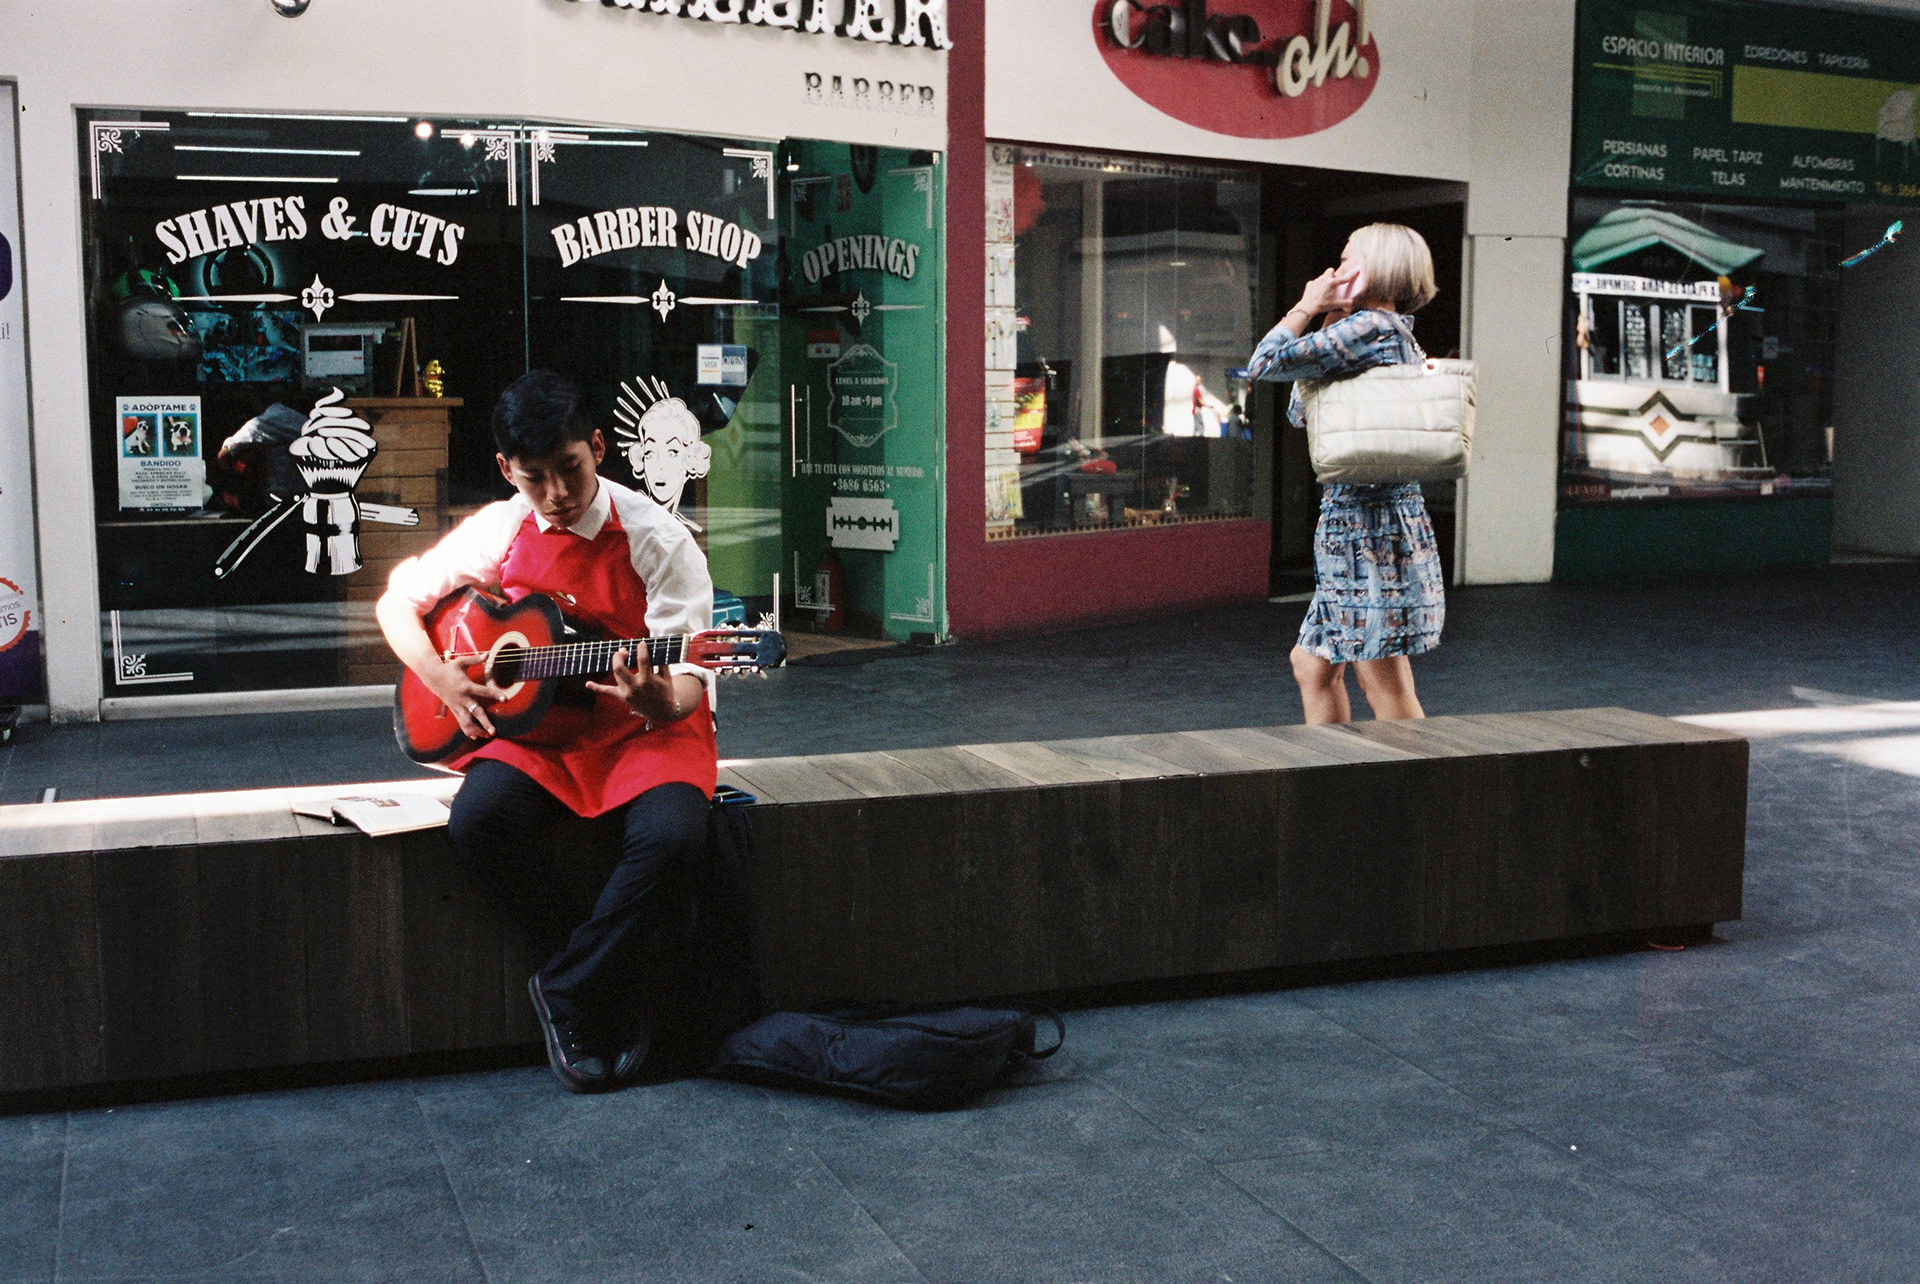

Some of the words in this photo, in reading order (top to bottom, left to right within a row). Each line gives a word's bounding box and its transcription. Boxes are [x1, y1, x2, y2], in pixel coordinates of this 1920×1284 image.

[1276, 0, 1370, 98] oh!
[1602, 35, 1659, 59] ESPACIO
[1664, 42, 1724, 66] INTERIOR
[1602, 139, 1668, 159] PERSIANAS
[1693, 147, 1728, 164] PAPEL
[1732, 149, 1763, 166] TAPIZ
[1604, 163, 1664, 182] CORTINAS
[1792, 154, 1855, 172] ALFOMBRAS
[1711, 171, 1746, 187] TELAS
[155, 196, 307, 265] SHAVES
[321, 196, 356, 241] &
[370, 203, 465, 266] CUTS
[551, 207, 677, 268] BARBER
[686, 210, 761, 269] SHOP
[802, 235, 920, 283] OPENINGS
[842, 395, 850, 406] 10
[823, 463, 838, 475] CITA
[838, 463, 851, 475] CON
[852, 464, 885, 476] NOSOTROS
